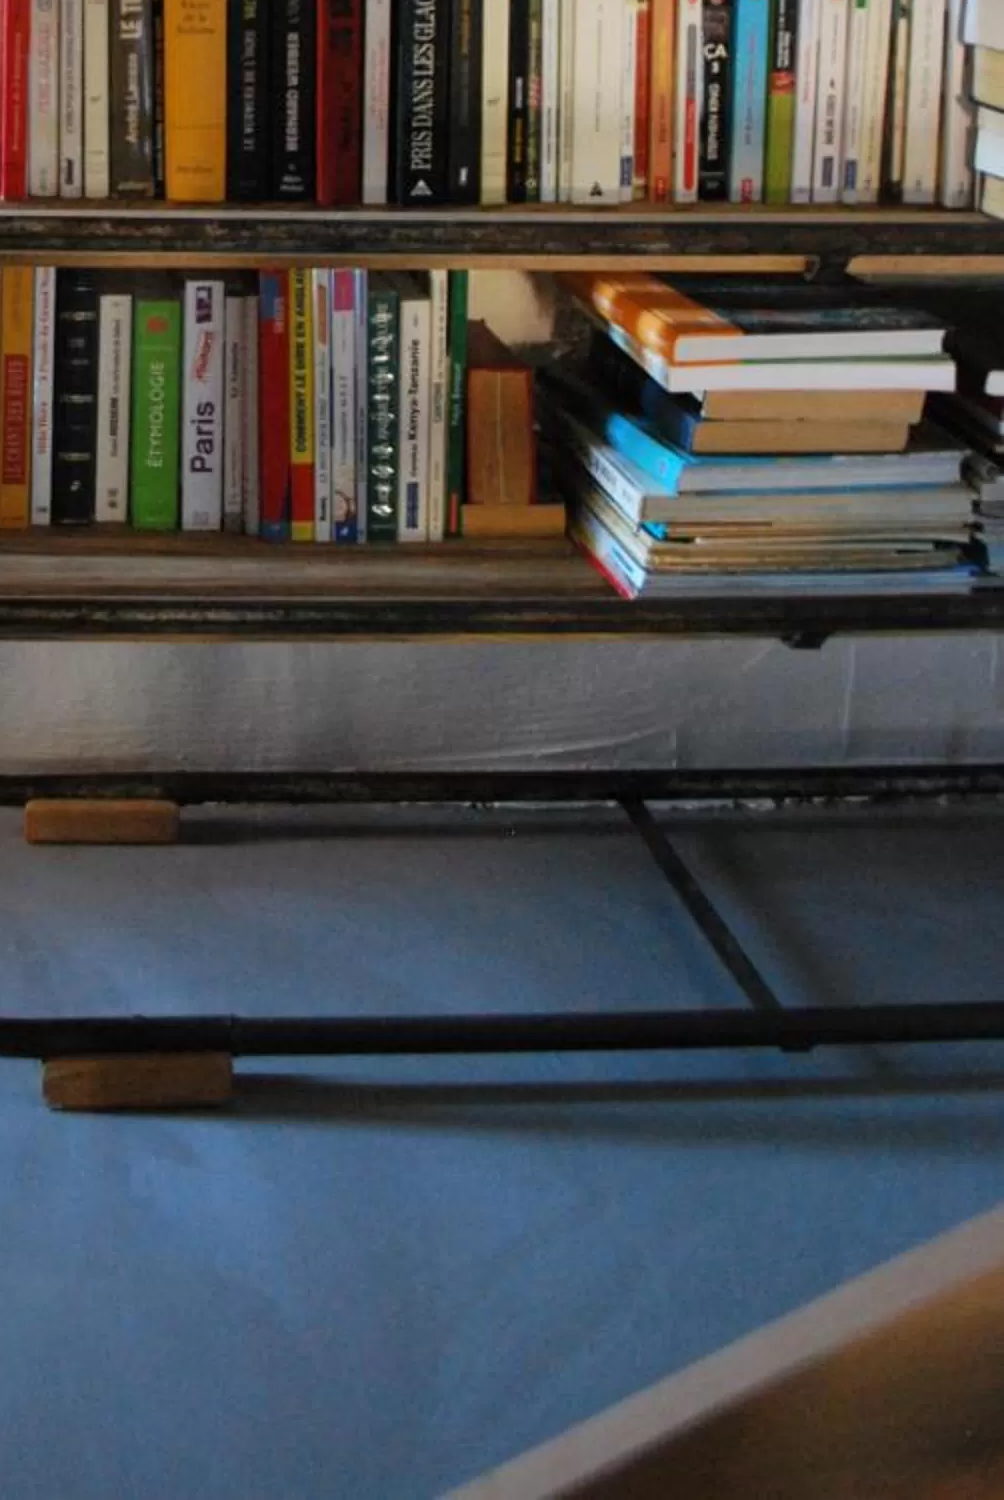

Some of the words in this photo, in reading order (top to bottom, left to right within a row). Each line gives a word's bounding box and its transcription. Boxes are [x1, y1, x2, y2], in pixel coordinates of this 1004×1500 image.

[119, 19, 143, 40] LE
[412, 44, 435, 77] LES
[285, 88, 300, 152] BERNARD
[411, 80, 434, 128] DANS
[706, 83, 722, 113] KING
[410, 131, 433, 172] PRIS
[294, 376, 306, 389] LE
[143, 360, 165, 469] ÉTYMOLOGIE
[294, 393, 307, 453] COMMENT
[189, 401, 215, 475] Paris
